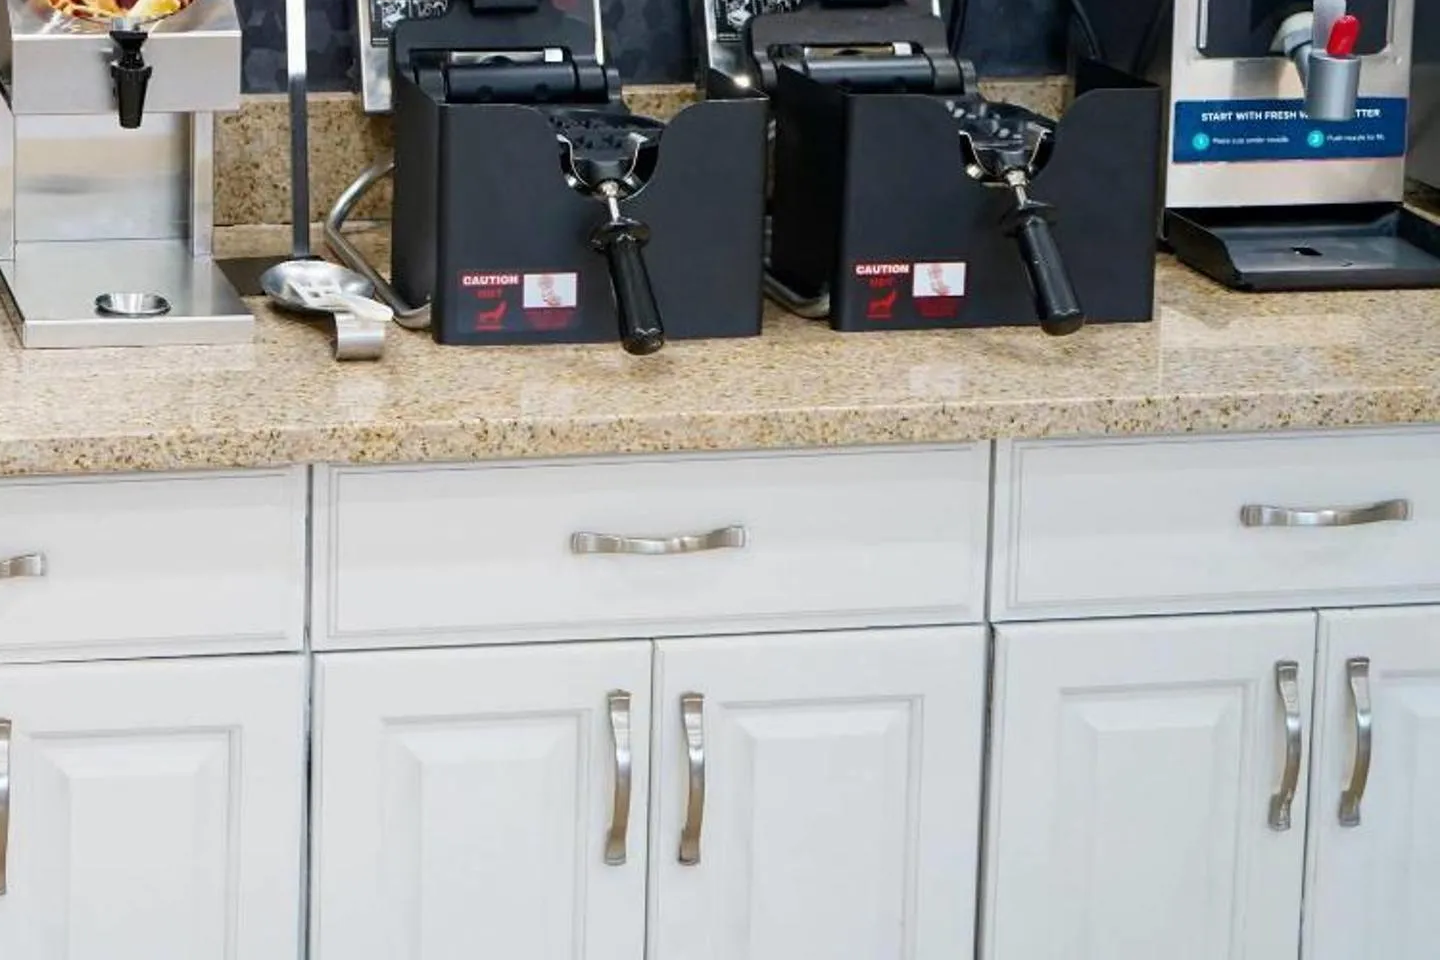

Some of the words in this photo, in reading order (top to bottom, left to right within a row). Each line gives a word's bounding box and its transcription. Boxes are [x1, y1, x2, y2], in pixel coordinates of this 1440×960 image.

[1201, 112, 1232, 122] START
[1236, 112, 1262, 121] WITH
[1264, 111, 1297, 120] FRESH
[856, 264, 909, 275] CAUTION
[463, 275, 518, 286] CAUTION
